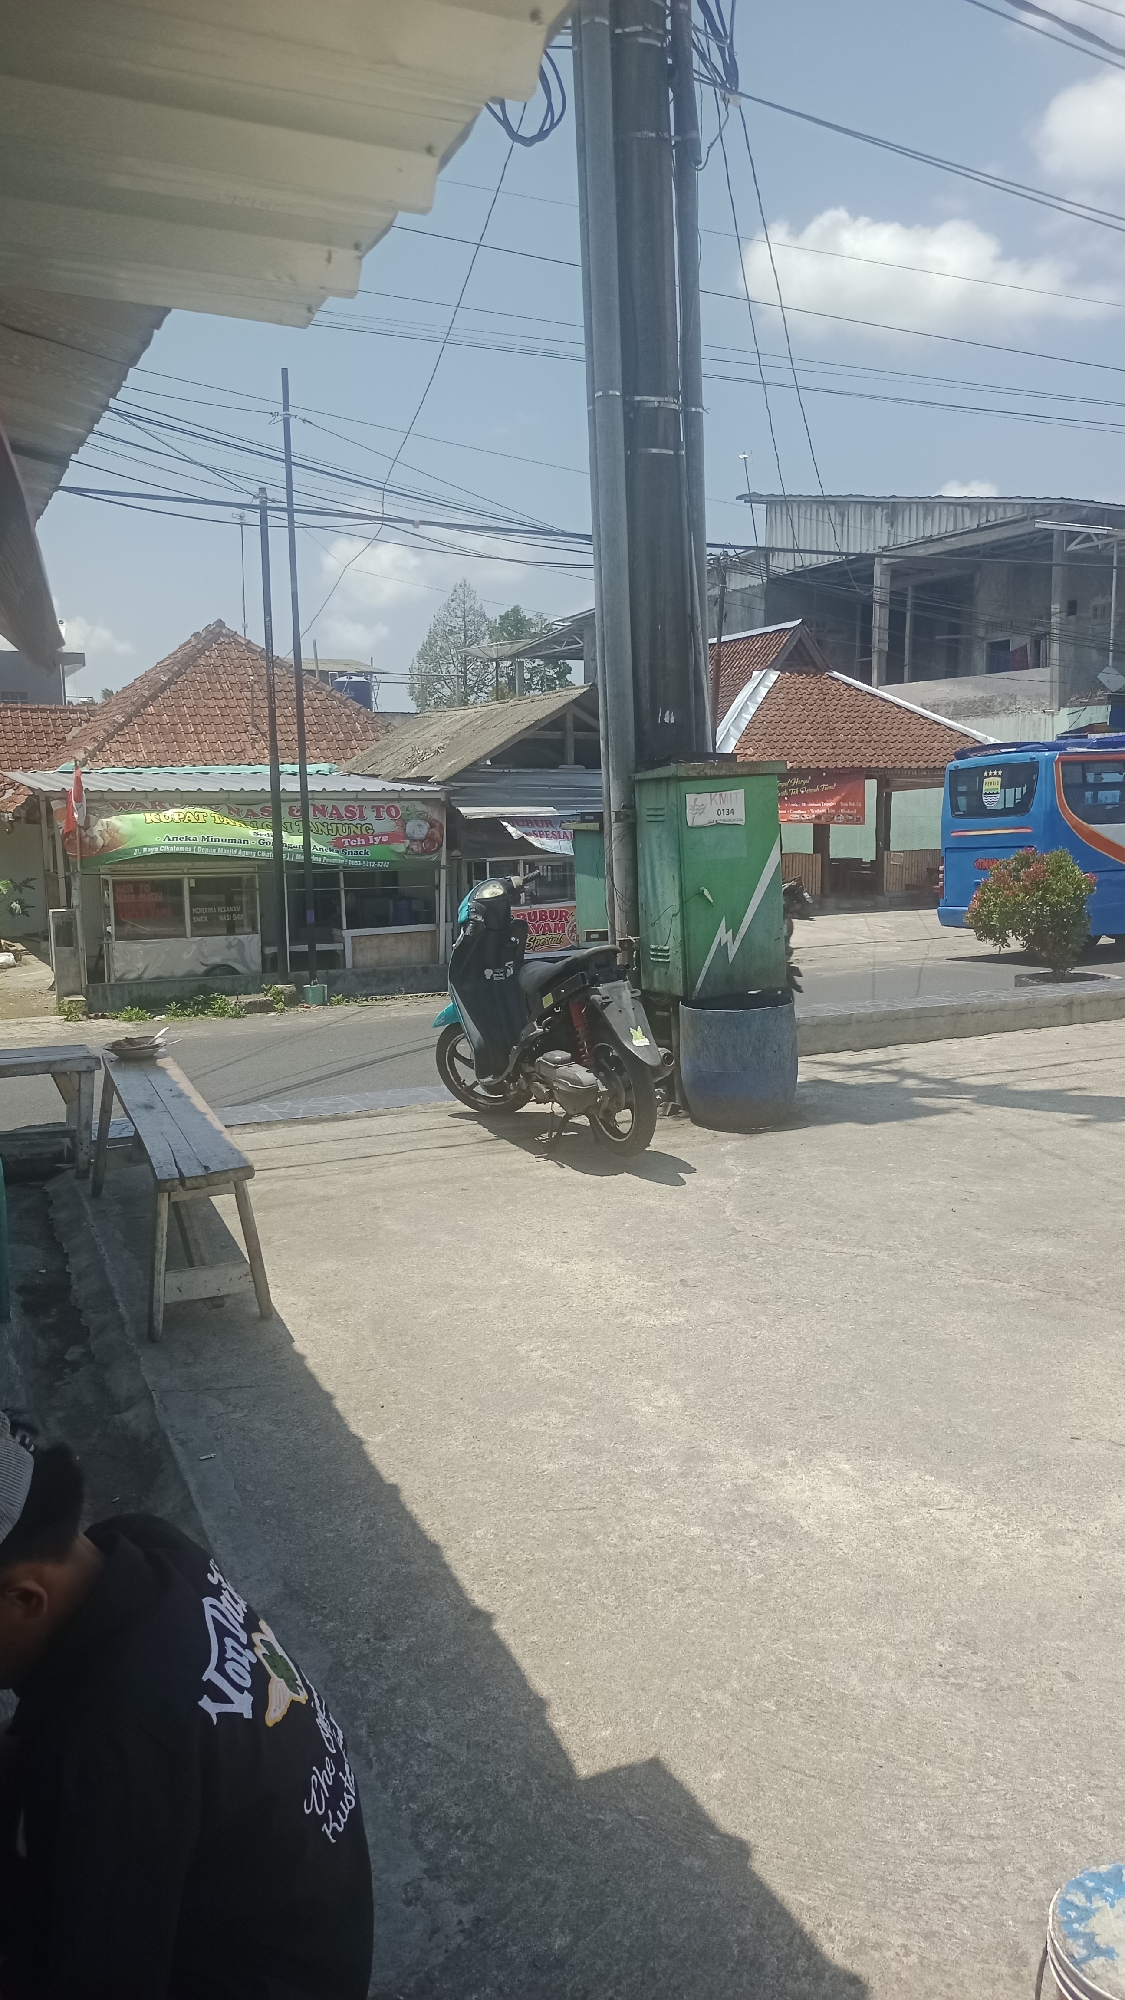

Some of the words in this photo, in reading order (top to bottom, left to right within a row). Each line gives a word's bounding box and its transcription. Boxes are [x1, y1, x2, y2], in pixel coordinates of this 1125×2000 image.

[709, 792, 740, 806] KMIT
[311, 804, 367, 820] NASI
[371, 804, 401, 820] TO
[716, 808, 735, 817] 0134
[162, 835, 198, 843] Aneka
[201, 835, 249, 846] Minuman
[341, 848, 370, 856] Snack
[138, 884, 151, 893] TO
